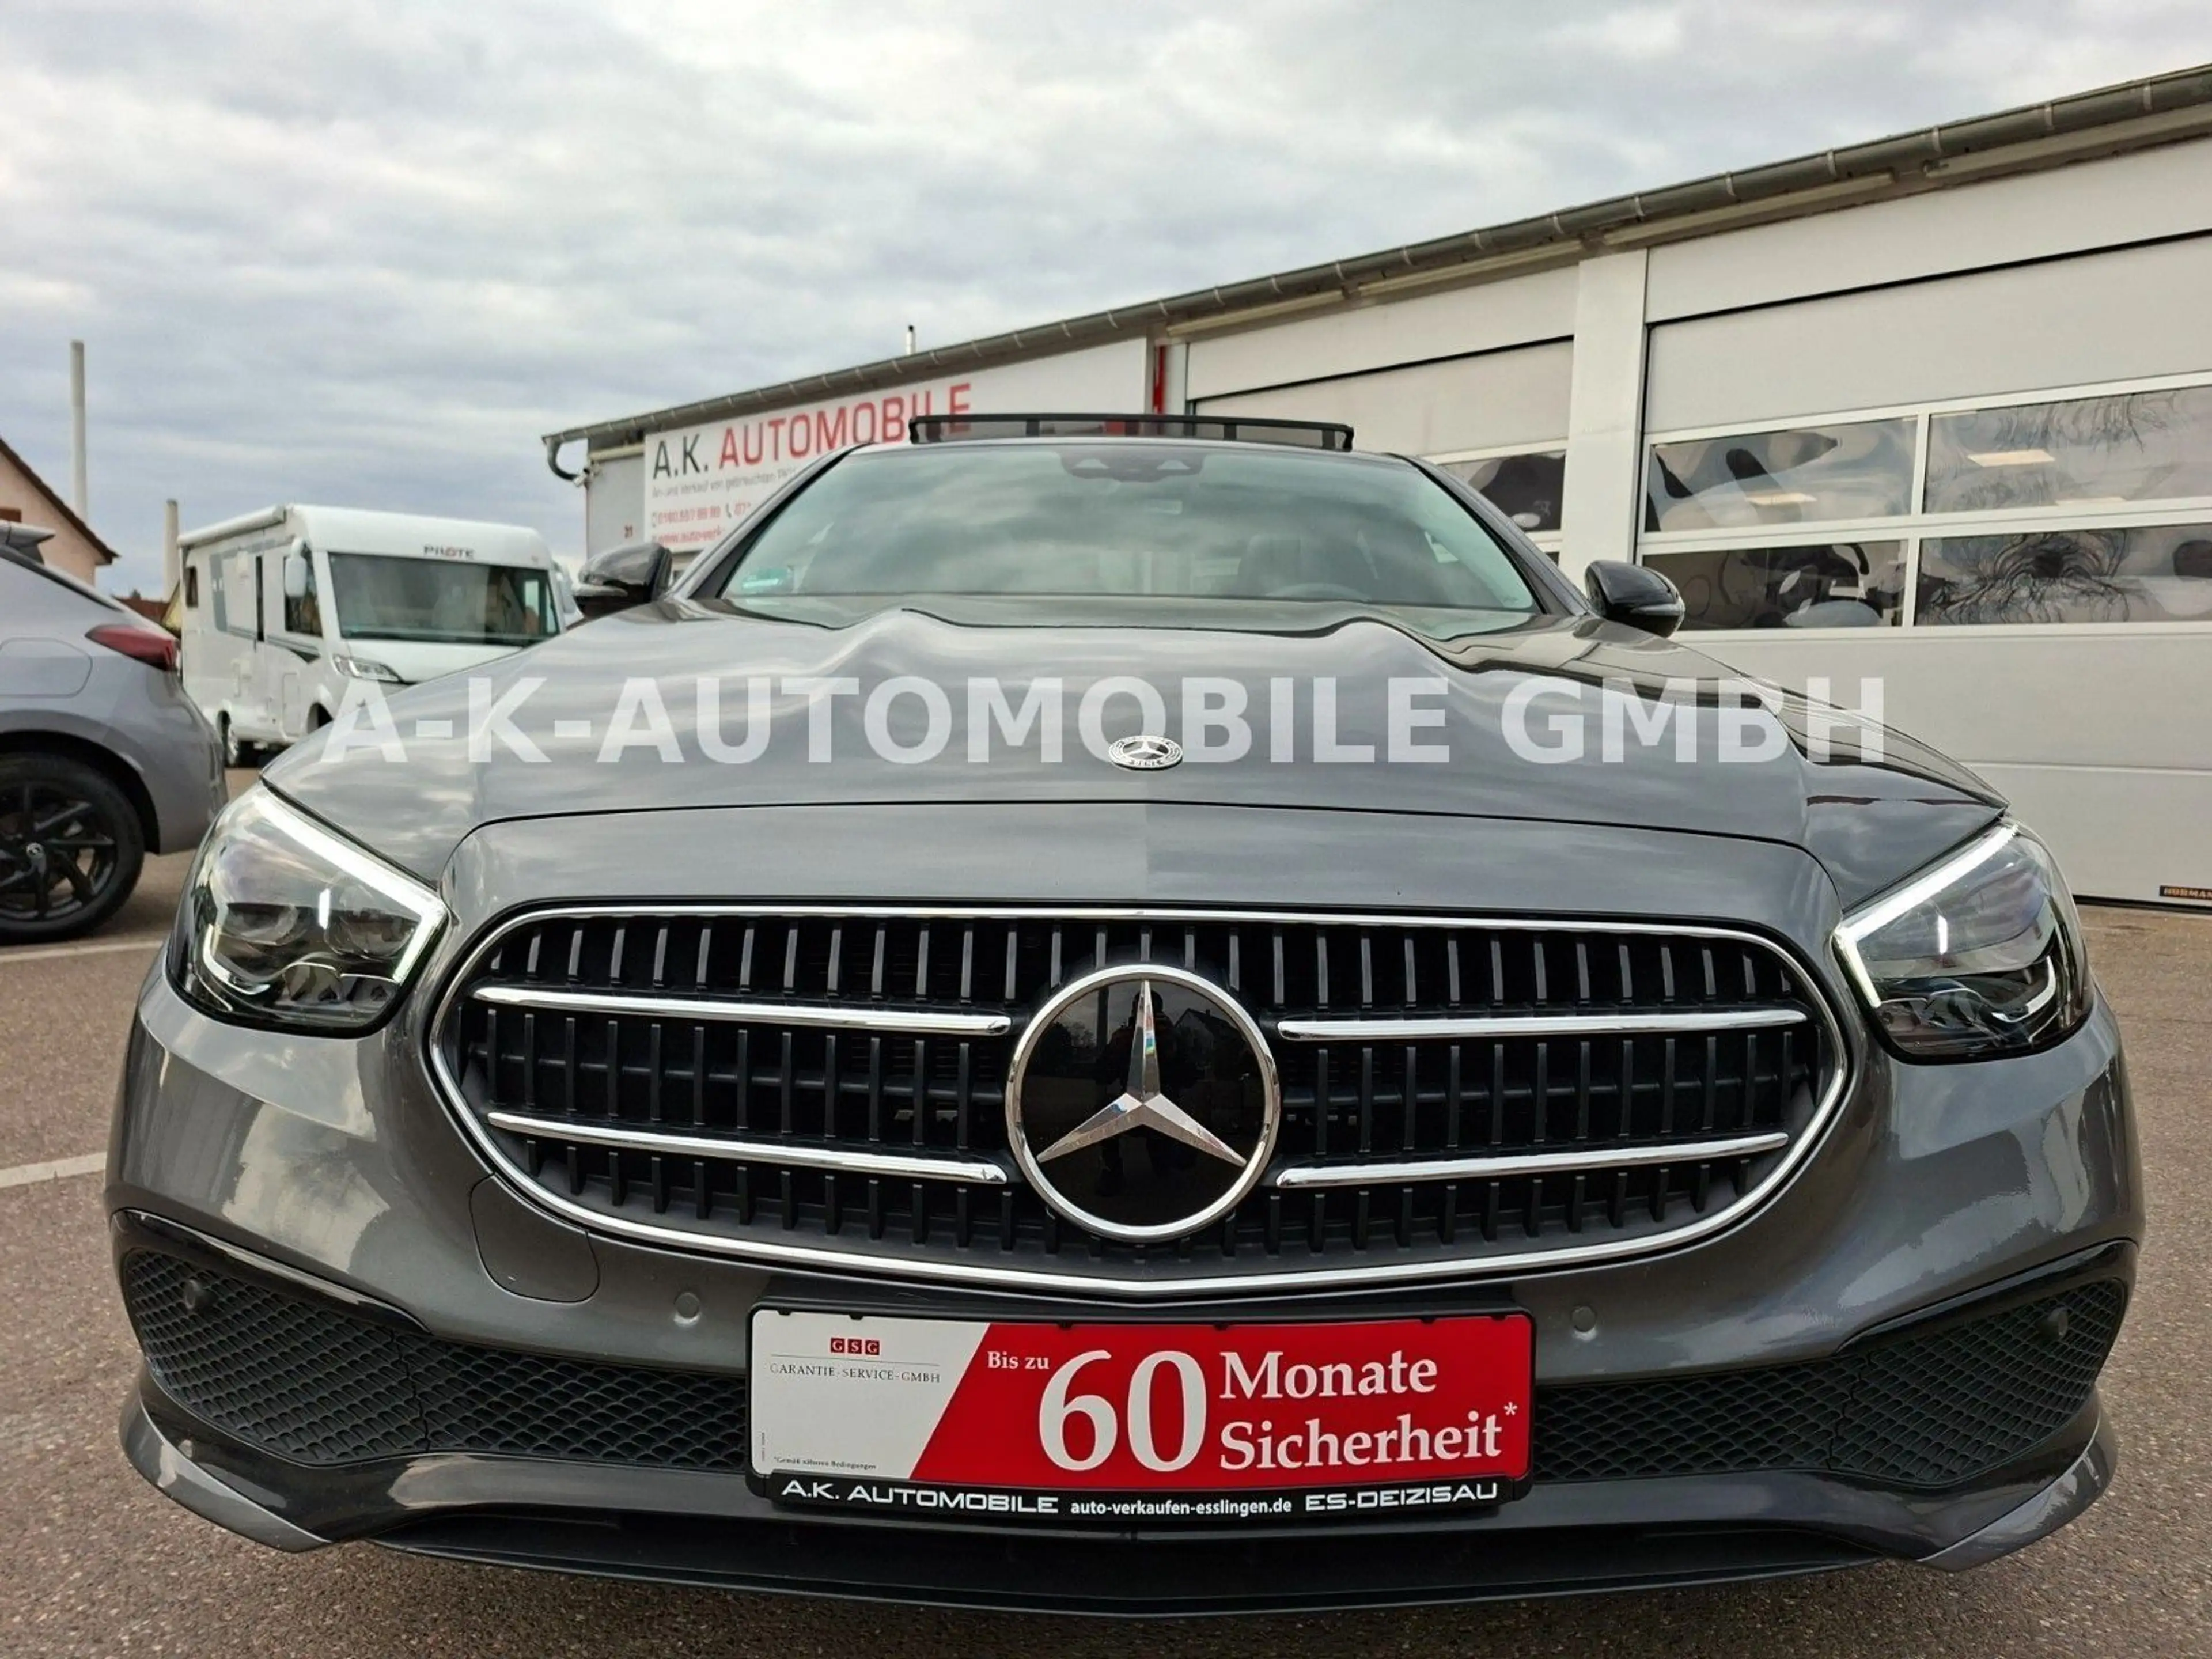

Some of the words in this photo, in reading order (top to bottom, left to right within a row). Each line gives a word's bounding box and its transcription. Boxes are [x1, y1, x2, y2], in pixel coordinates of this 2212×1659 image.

[652, 434, 709, 480] A.K.
[719, 383, 971, 470] AUTOMOBILE
[831, 1337, 880, 1355] GSG
[987, 1351, 1018, 1369] Bis
[1025, 1358, 1050, 1370] zu
[1219, 1350, 1438, 1399] Monate
[1039, 1350, 1207, 1471] 60
[781, 1479, 839, 1500] A.K.
[847, 1484, 1059, 1514] AUTOMOBILE
[1070, 1497, 1293, 1518] auto-verkaufen-esslingen.de
[1305, 1482, 1498, 1512] ES-DEIZISAU
